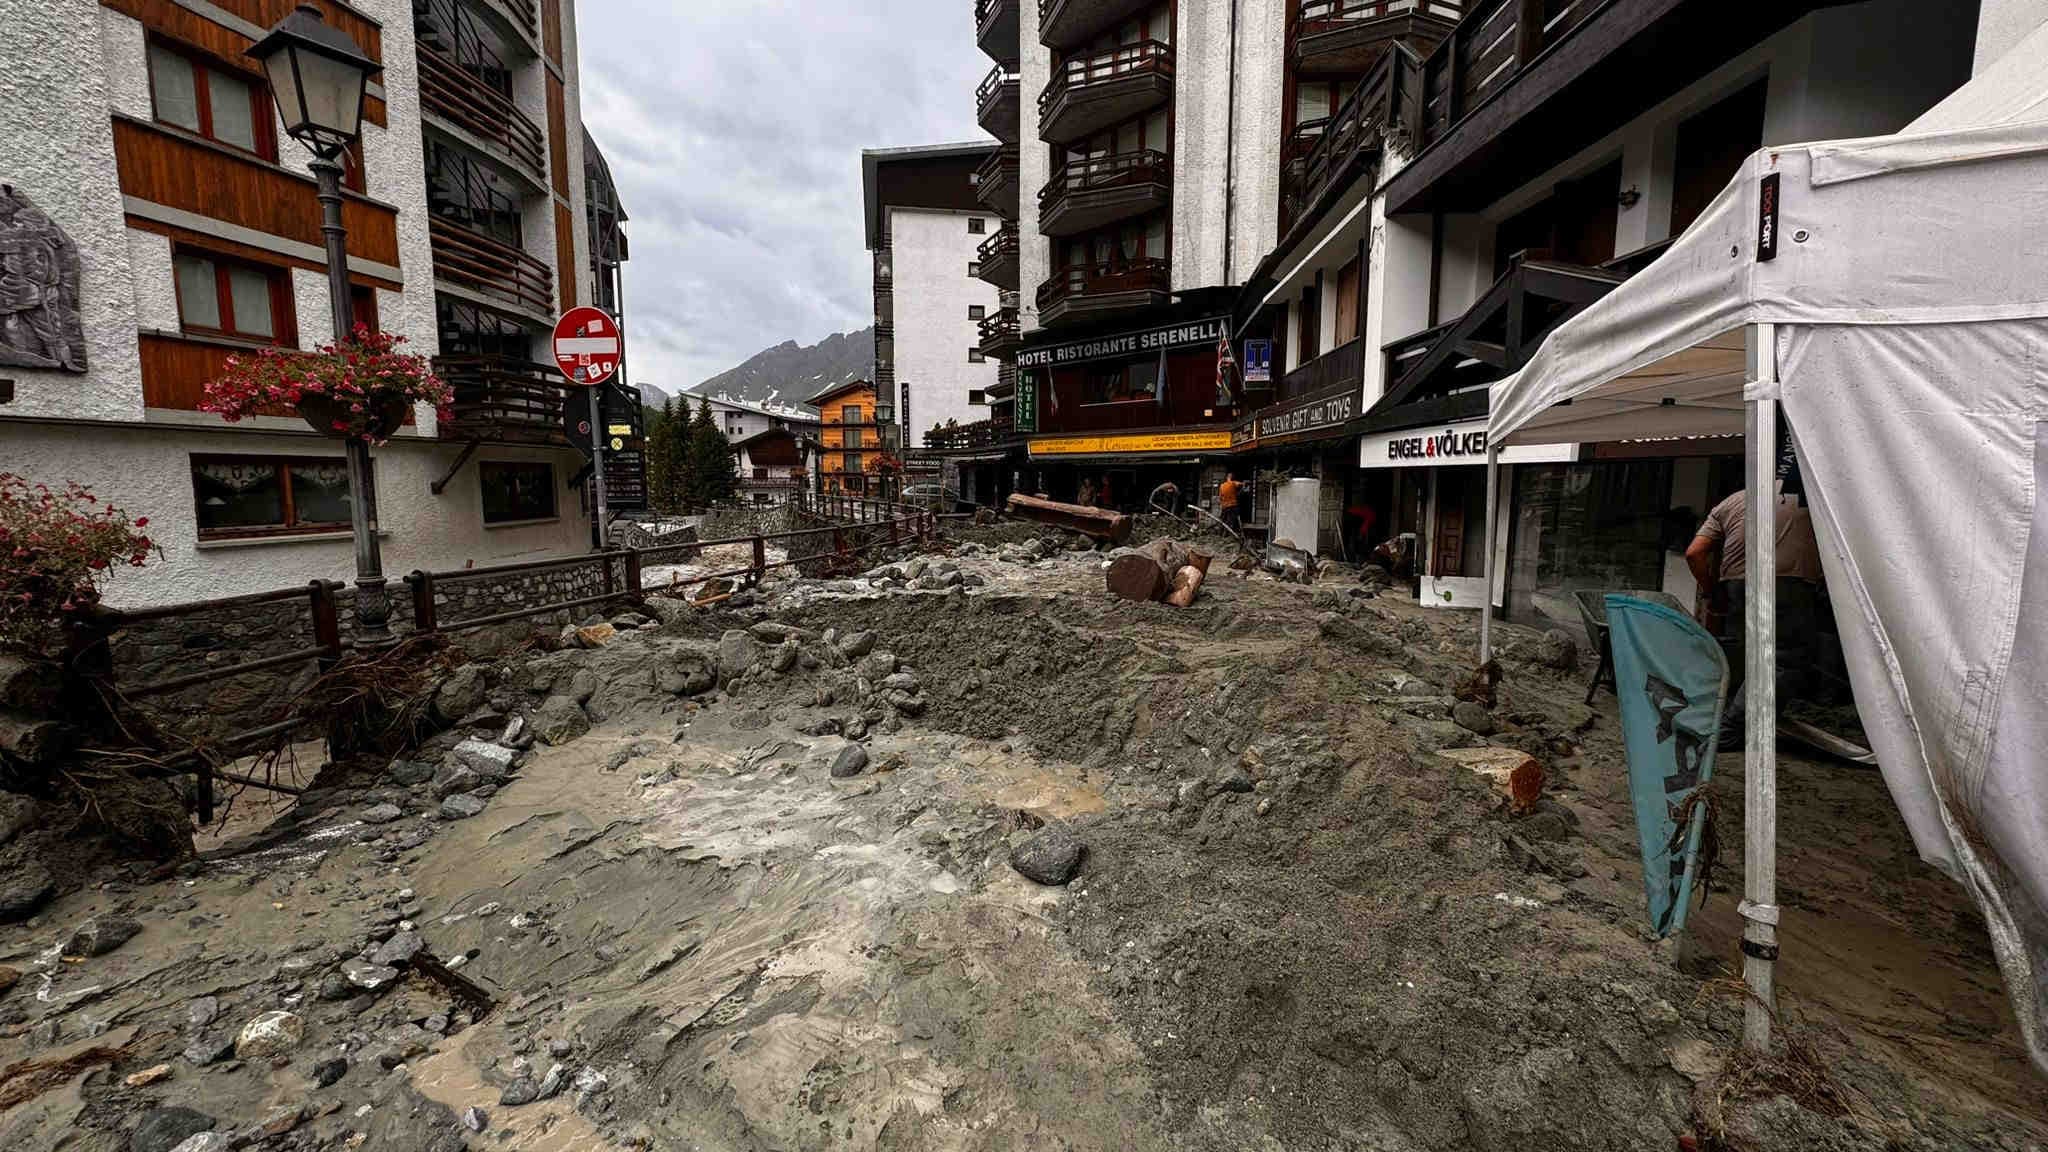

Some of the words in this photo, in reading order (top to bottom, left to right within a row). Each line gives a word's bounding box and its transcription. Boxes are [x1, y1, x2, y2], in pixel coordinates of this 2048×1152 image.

[1017, 351, 1053, 367] HOTEL
[1057, 337, 1137, 362] RISTORANTE
[1262, 414, 1291, 435] SOUVENIR
[1292, 408, 1308, 430] GIFT
[1310, 407, 1324, 422] AND
[1326, 397, 1351, 421] TOYS
